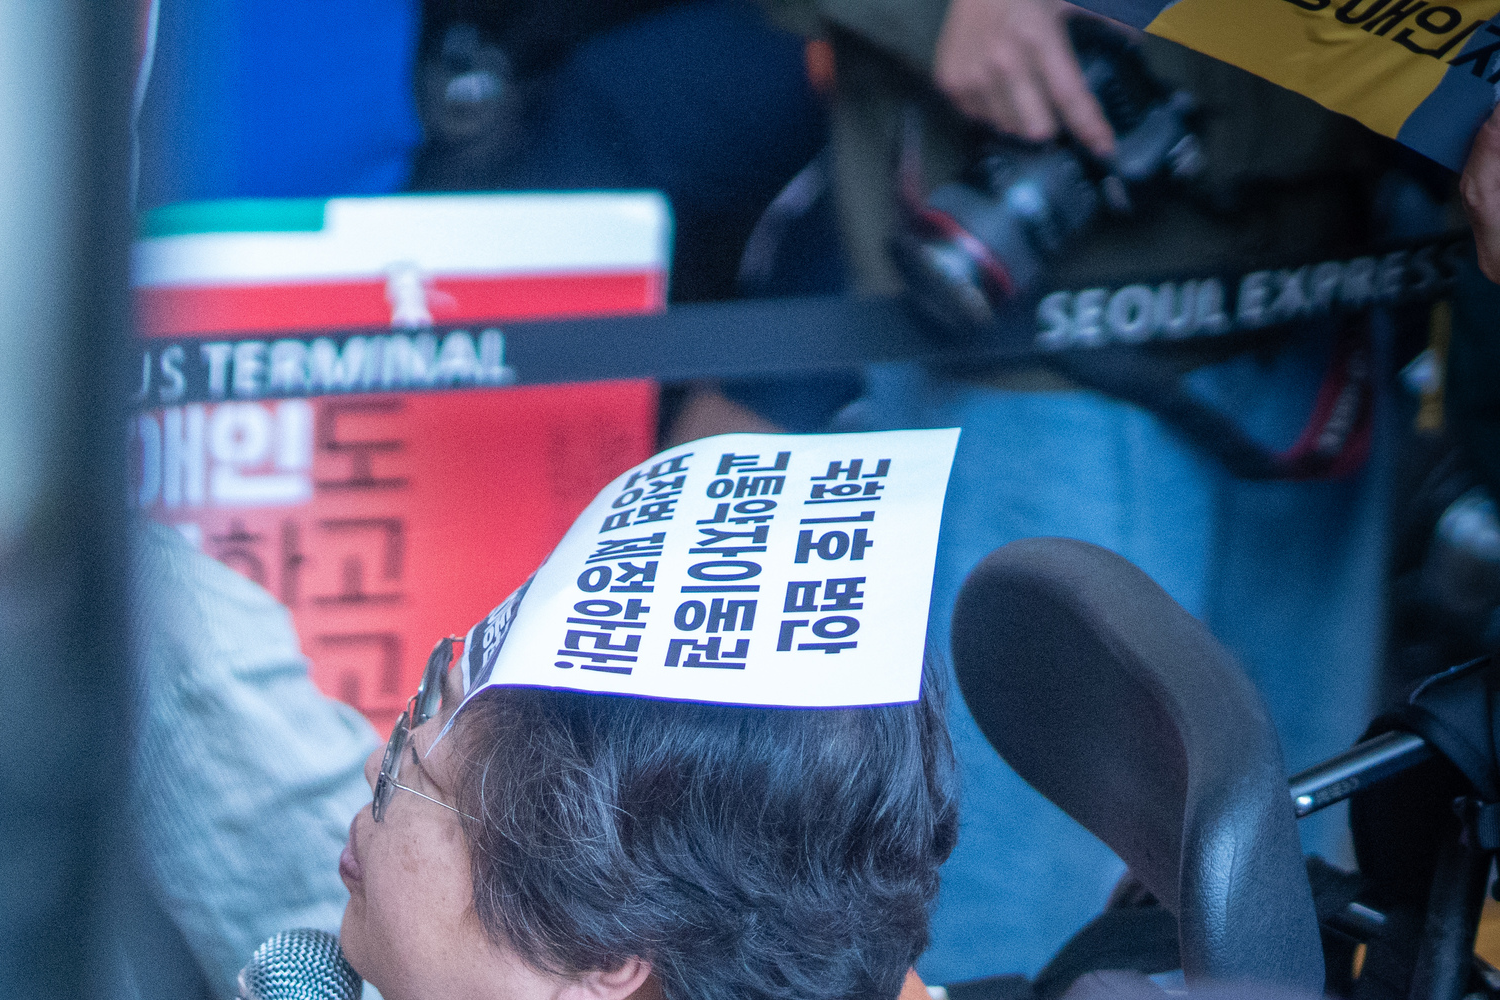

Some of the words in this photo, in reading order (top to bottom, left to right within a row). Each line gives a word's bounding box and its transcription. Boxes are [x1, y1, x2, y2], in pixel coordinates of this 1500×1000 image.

[1037, 278, 1232, 350] SEOUL
[1236, 249, 1460, 323] EXPRESS
[202, 328, 516, 396] TERMINAL
[599, 452, 694, 533] 보장법
[804, 458, 891, 505] 국회
[664, 451, 792, 670] 교통약자이동권
[794, 510, 876, 564] 1호
[554, 532, 667, 675] 제정하라!
[776, 576, 867, 654] 법안
